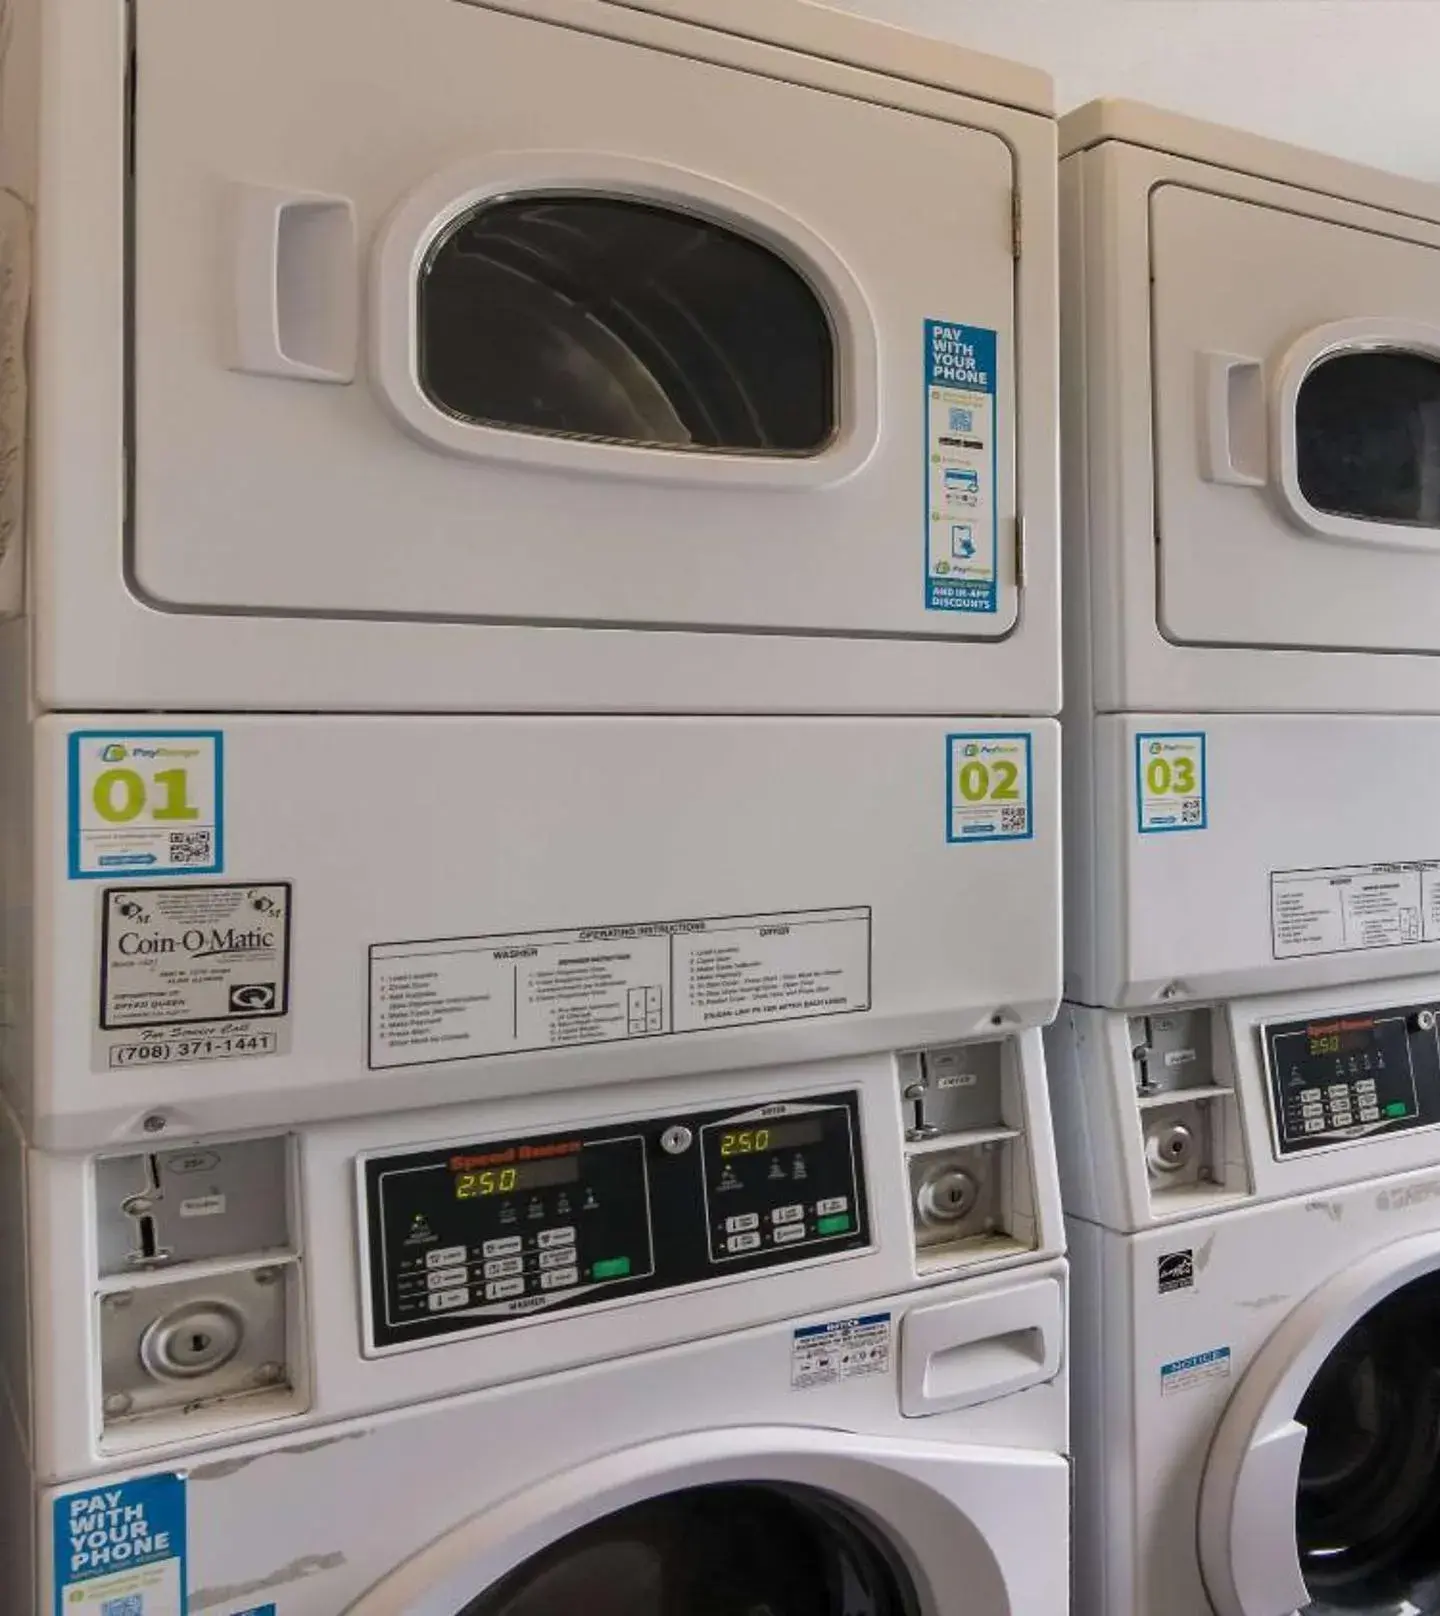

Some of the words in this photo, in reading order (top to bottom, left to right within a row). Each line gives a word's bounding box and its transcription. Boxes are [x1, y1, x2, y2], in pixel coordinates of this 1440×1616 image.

[933, 326, 962, 340] PAY
[933, 339, 974, 356] WITH
[933, 352, 976, 369] YOUR
[933, 366, 988, 384] PHONE
[932, 597, 991, 609] DISCOUNTS
[960, 760, 1020, 801] 02
[1147, 756, 1196, 795] 03
[92, 768, 199, 822] 01
[493, 948, 538, 960] WASHER
[118, 1044, 171, 1064] (708)
[177, 1036, 269, 1056] 371-1441
[457, 1169, 516, 1198] 2.50
[70, 1489, 122, 1517] PAY
[69, 1503, 143, 1535] WITH
[69, 1520, 149, 1552] YOUR
[71, 1531, 170, 1571] PHONE
